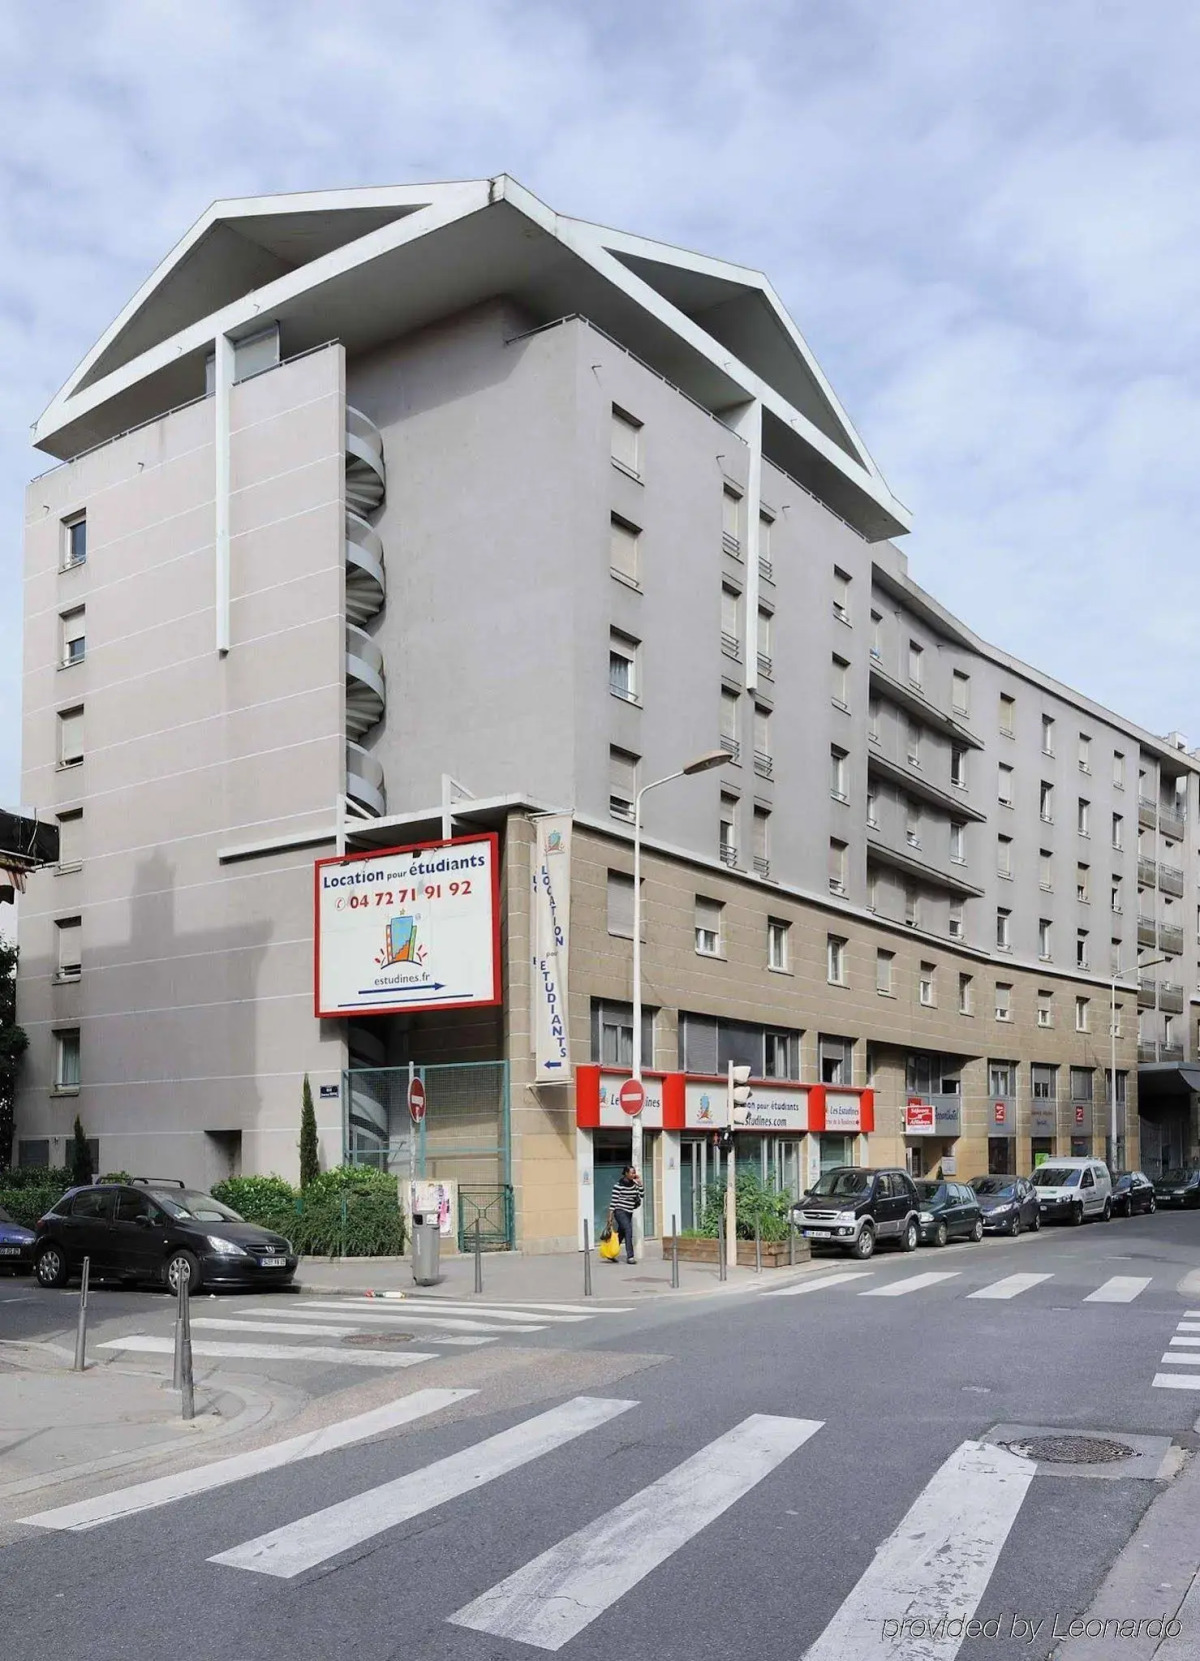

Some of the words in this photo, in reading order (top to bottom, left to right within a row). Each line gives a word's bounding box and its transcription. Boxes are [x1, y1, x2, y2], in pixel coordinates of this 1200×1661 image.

[323, 869, 384, 889] Location
[386, 871, 408, 882] pour
[409, 854, 485, 876] étudiants
[350, 896, 369, 909] 04
[375, 892, 394, 906] 72
[398, 888, 416, 903] 71
[424, 884, 441, 899] 91
[449, 880, 472, 896] 92
[541, 865, 564, 947] LOCATION
[374, 972, 430, 986] estudines.fr
[540, 960, 567, 1058] ETUDIANTS
